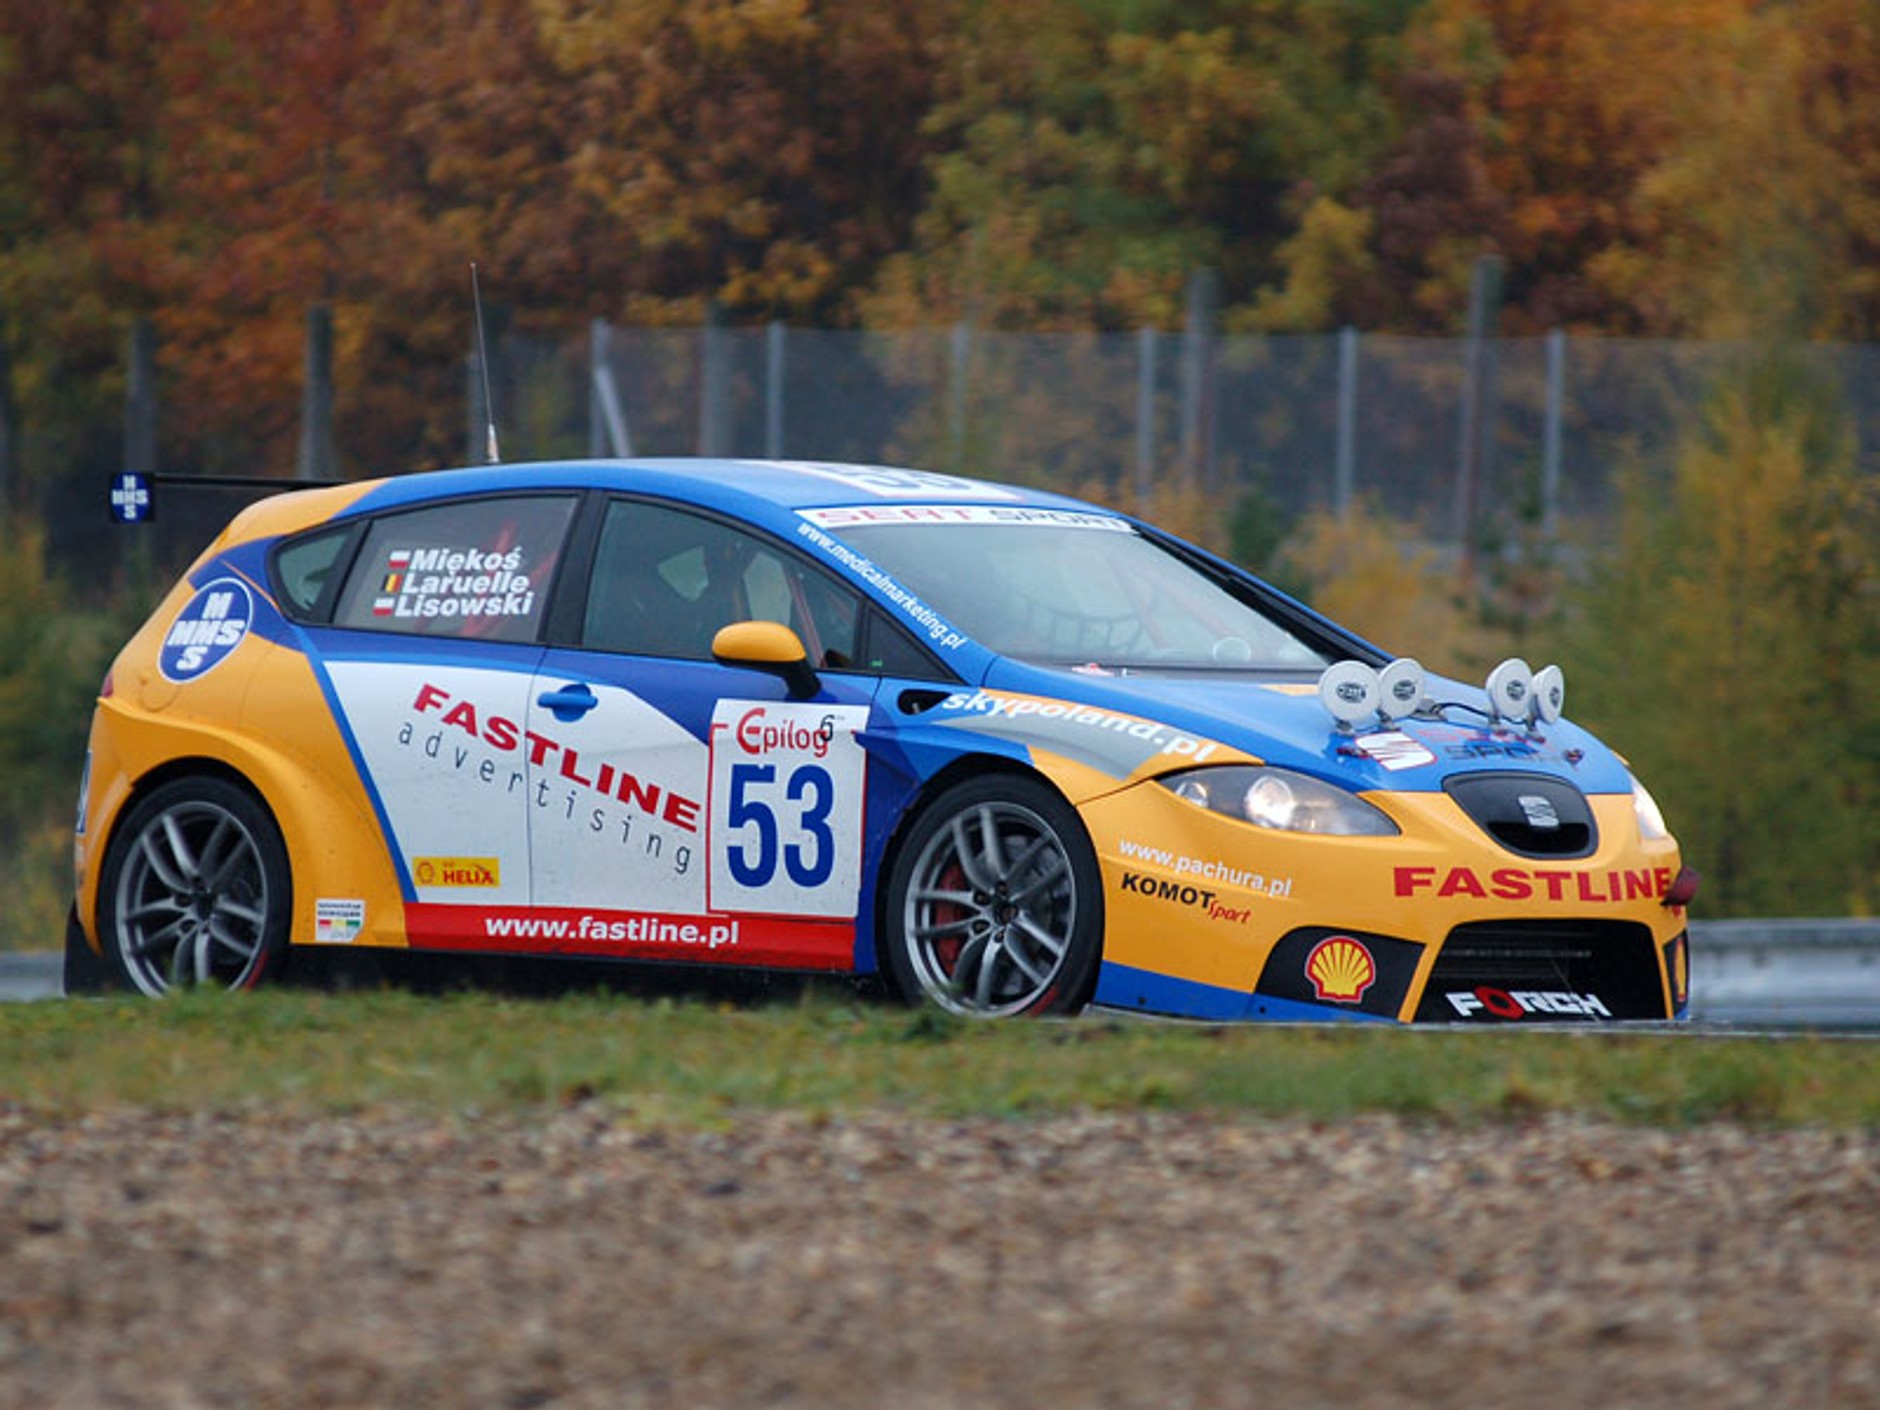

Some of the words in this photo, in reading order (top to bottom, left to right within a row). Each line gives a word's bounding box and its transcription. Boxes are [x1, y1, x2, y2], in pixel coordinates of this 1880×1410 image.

[817, 507, 974, 523] SEAT
[990, 510, 1124, 528] SPORT
[408, 546, 522, 574] Miękoś
[402, 571, 530, 594] Laruelle
[797, 521, 968, 650] www.medicalmarketing.pl
[201, 592, 234, 619] M
[395, 591, 534, 617] Lisowski
[166, 620, 245, 646] MMS
[175, 646, 208, 671] S
[736, 707, 829, 758] Epilog
[941, 691, 1218, 763] skypoland.pl
[413, 683, 701, 833] FASTLINE
[399, 722, 691, 875] advertising
[727, 764, 835, 888] 53
[443, 869, 494, 884] HELIX
[1119, 839, 1293, 897] www.pachura.pl
[1393, 867, 1673, 902] FASTLINE
[1121, 872, 1216, 909] KOMOT
[484, 916, 740, 949] www.fastline.pl
